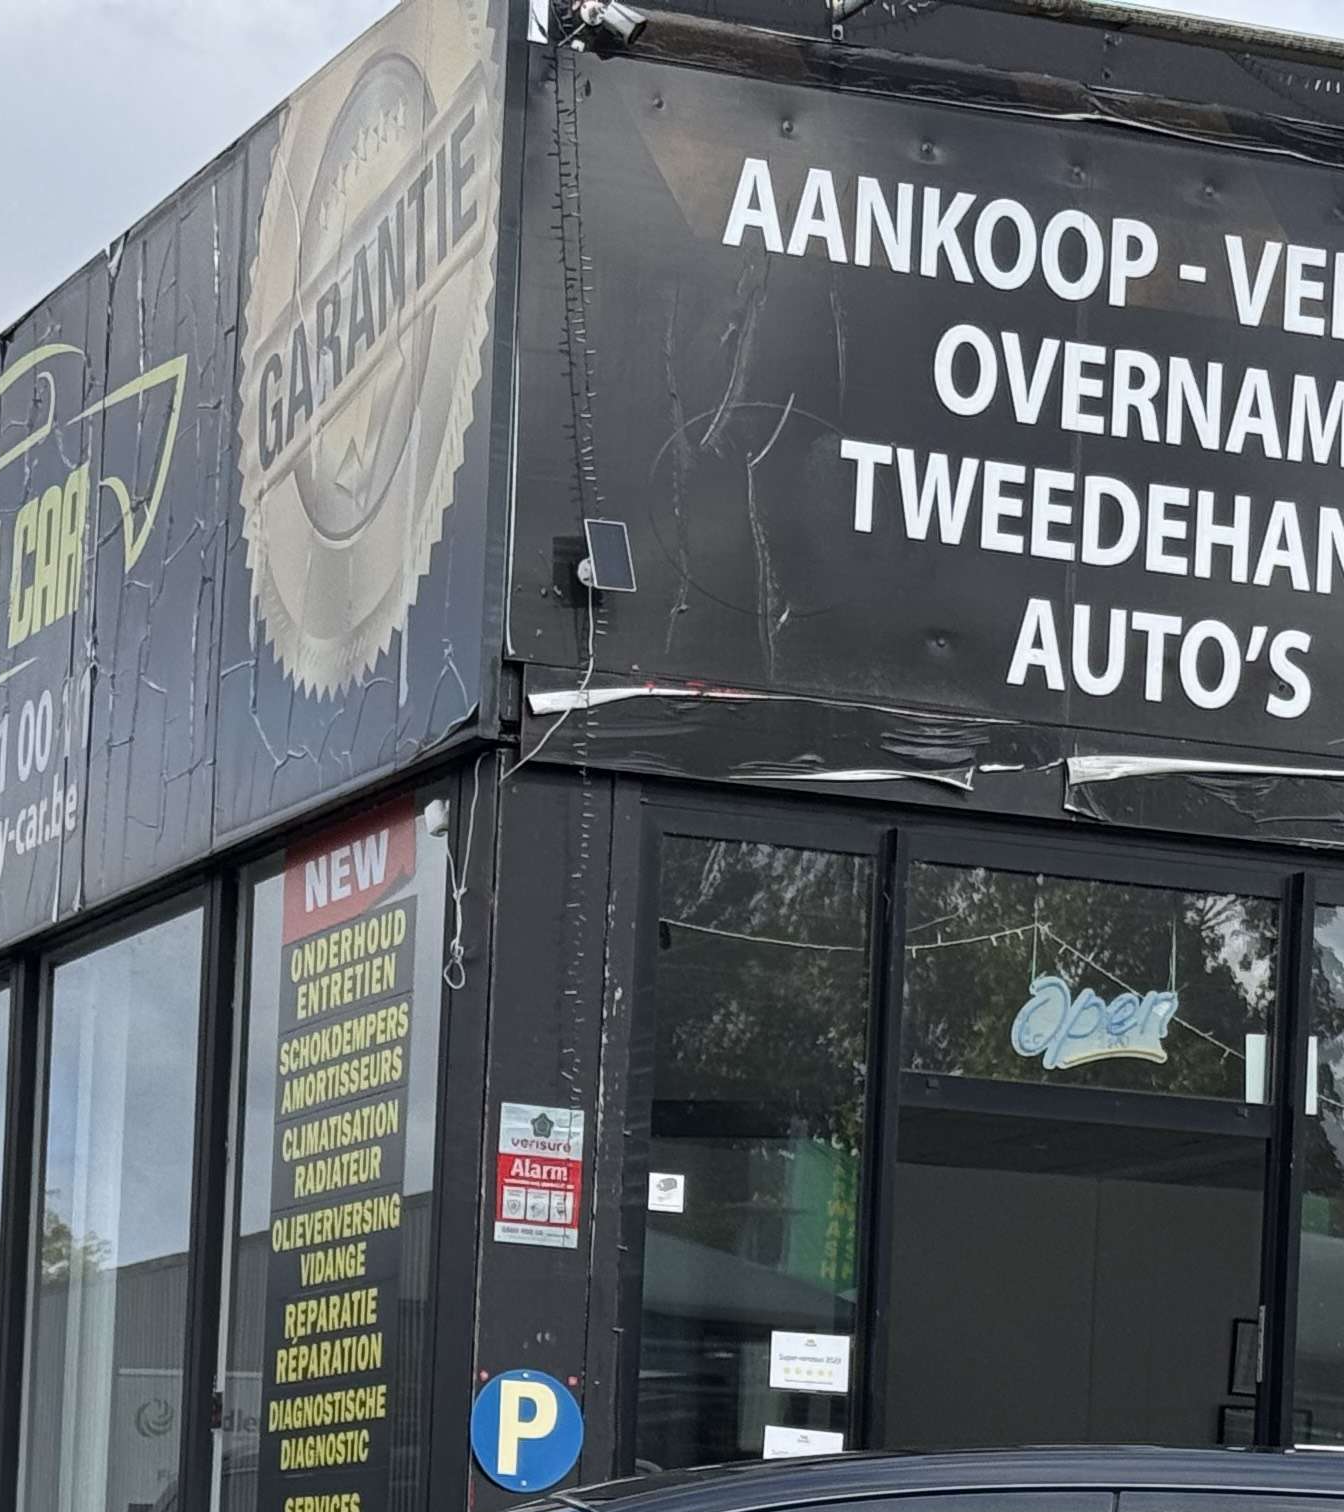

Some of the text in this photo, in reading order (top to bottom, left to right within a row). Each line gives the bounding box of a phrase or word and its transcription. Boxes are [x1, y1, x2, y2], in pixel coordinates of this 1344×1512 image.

[722, 157, 1159, 308] AANKOOP
[258, 103, 478, 471] GARANTIE
[8, 462, 91, 649] CAR
[1007, 598, 1311, 719] AUTO'S
[18, 689, 52, 782] 00
[304, 828, 390, 914] NEW
[291, 908, 407, 983] ONDERHOUD
[296, 951, 397, 1020] ENTRETIEN
[279, 1001, 410, 1076] SCHOKDEMPERS
[281, 1045, 403, 1115] AMORTISSEURS
[282, 1098, 399, 1163] CLIMATISATION
[294, 1145, 382, 1199] RADIATEUR
[510, 1158, 569, 1182] Alarm
[271, 1192, 401, 1253] OLIEVERVERSING
[300, 1241, 367, 1287] VIDANGE
[284, 1287, 379, 1339] REPARATIE
[268, 1384, 388, 1433] DIAGNOSTISCHE
[496, 1378, 558, 1476] P
[280, 1429, 370, 1471] DIAGNOSTIC
